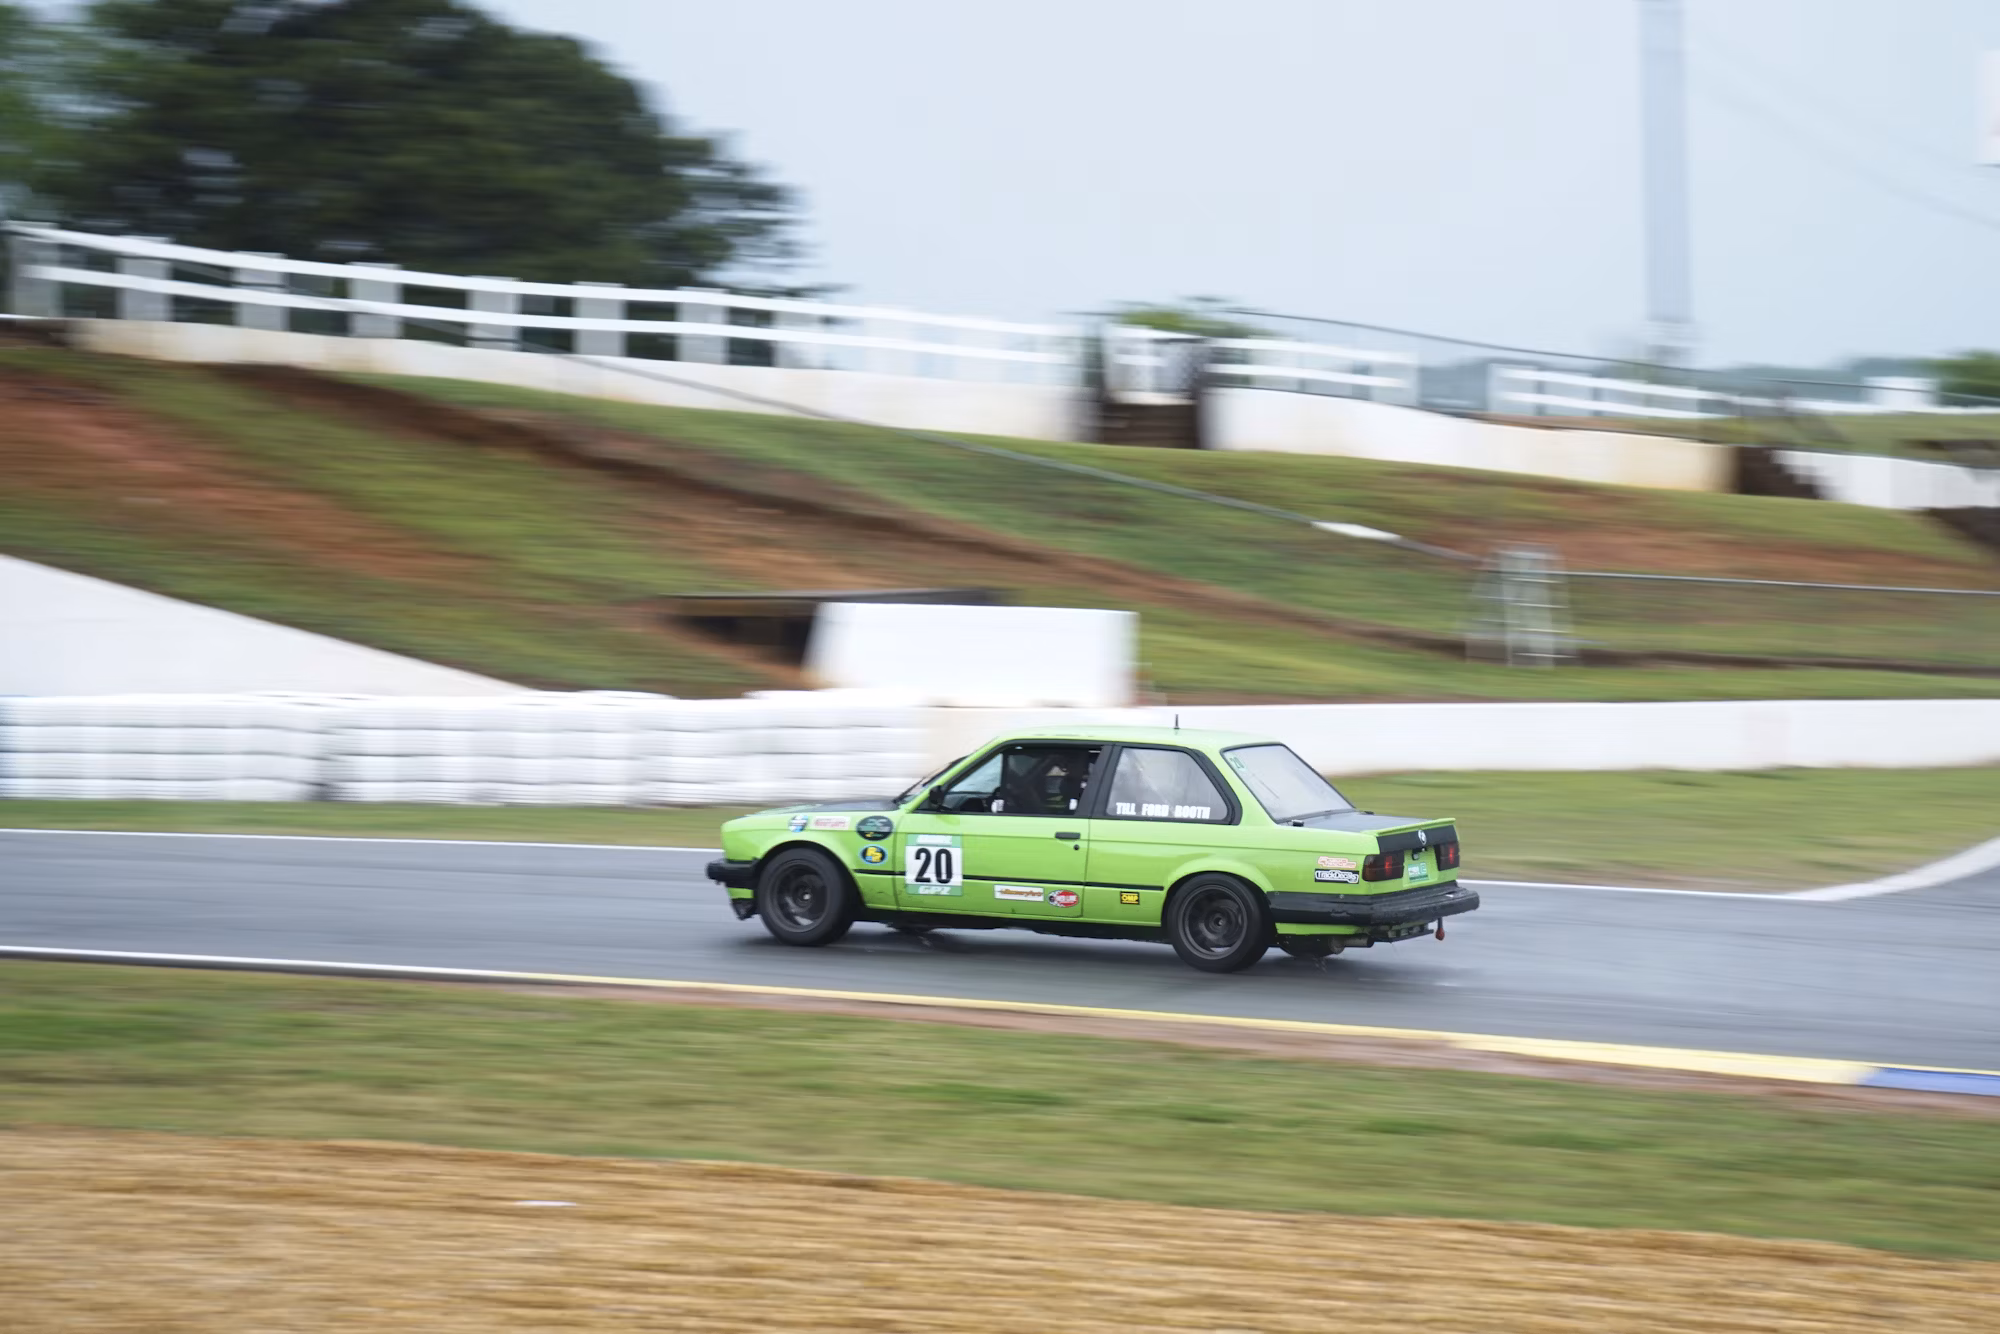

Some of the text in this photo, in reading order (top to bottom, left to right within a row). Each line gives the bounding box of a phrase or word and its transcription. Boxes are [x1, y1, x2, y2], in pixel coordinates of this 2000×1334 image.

[1116, 802, 1136, 815] TILL
[1141, 803, 1170, 817] FORD
[914, 847, 953, 884] 20
[1122, 894, 1139, 902] OMP
